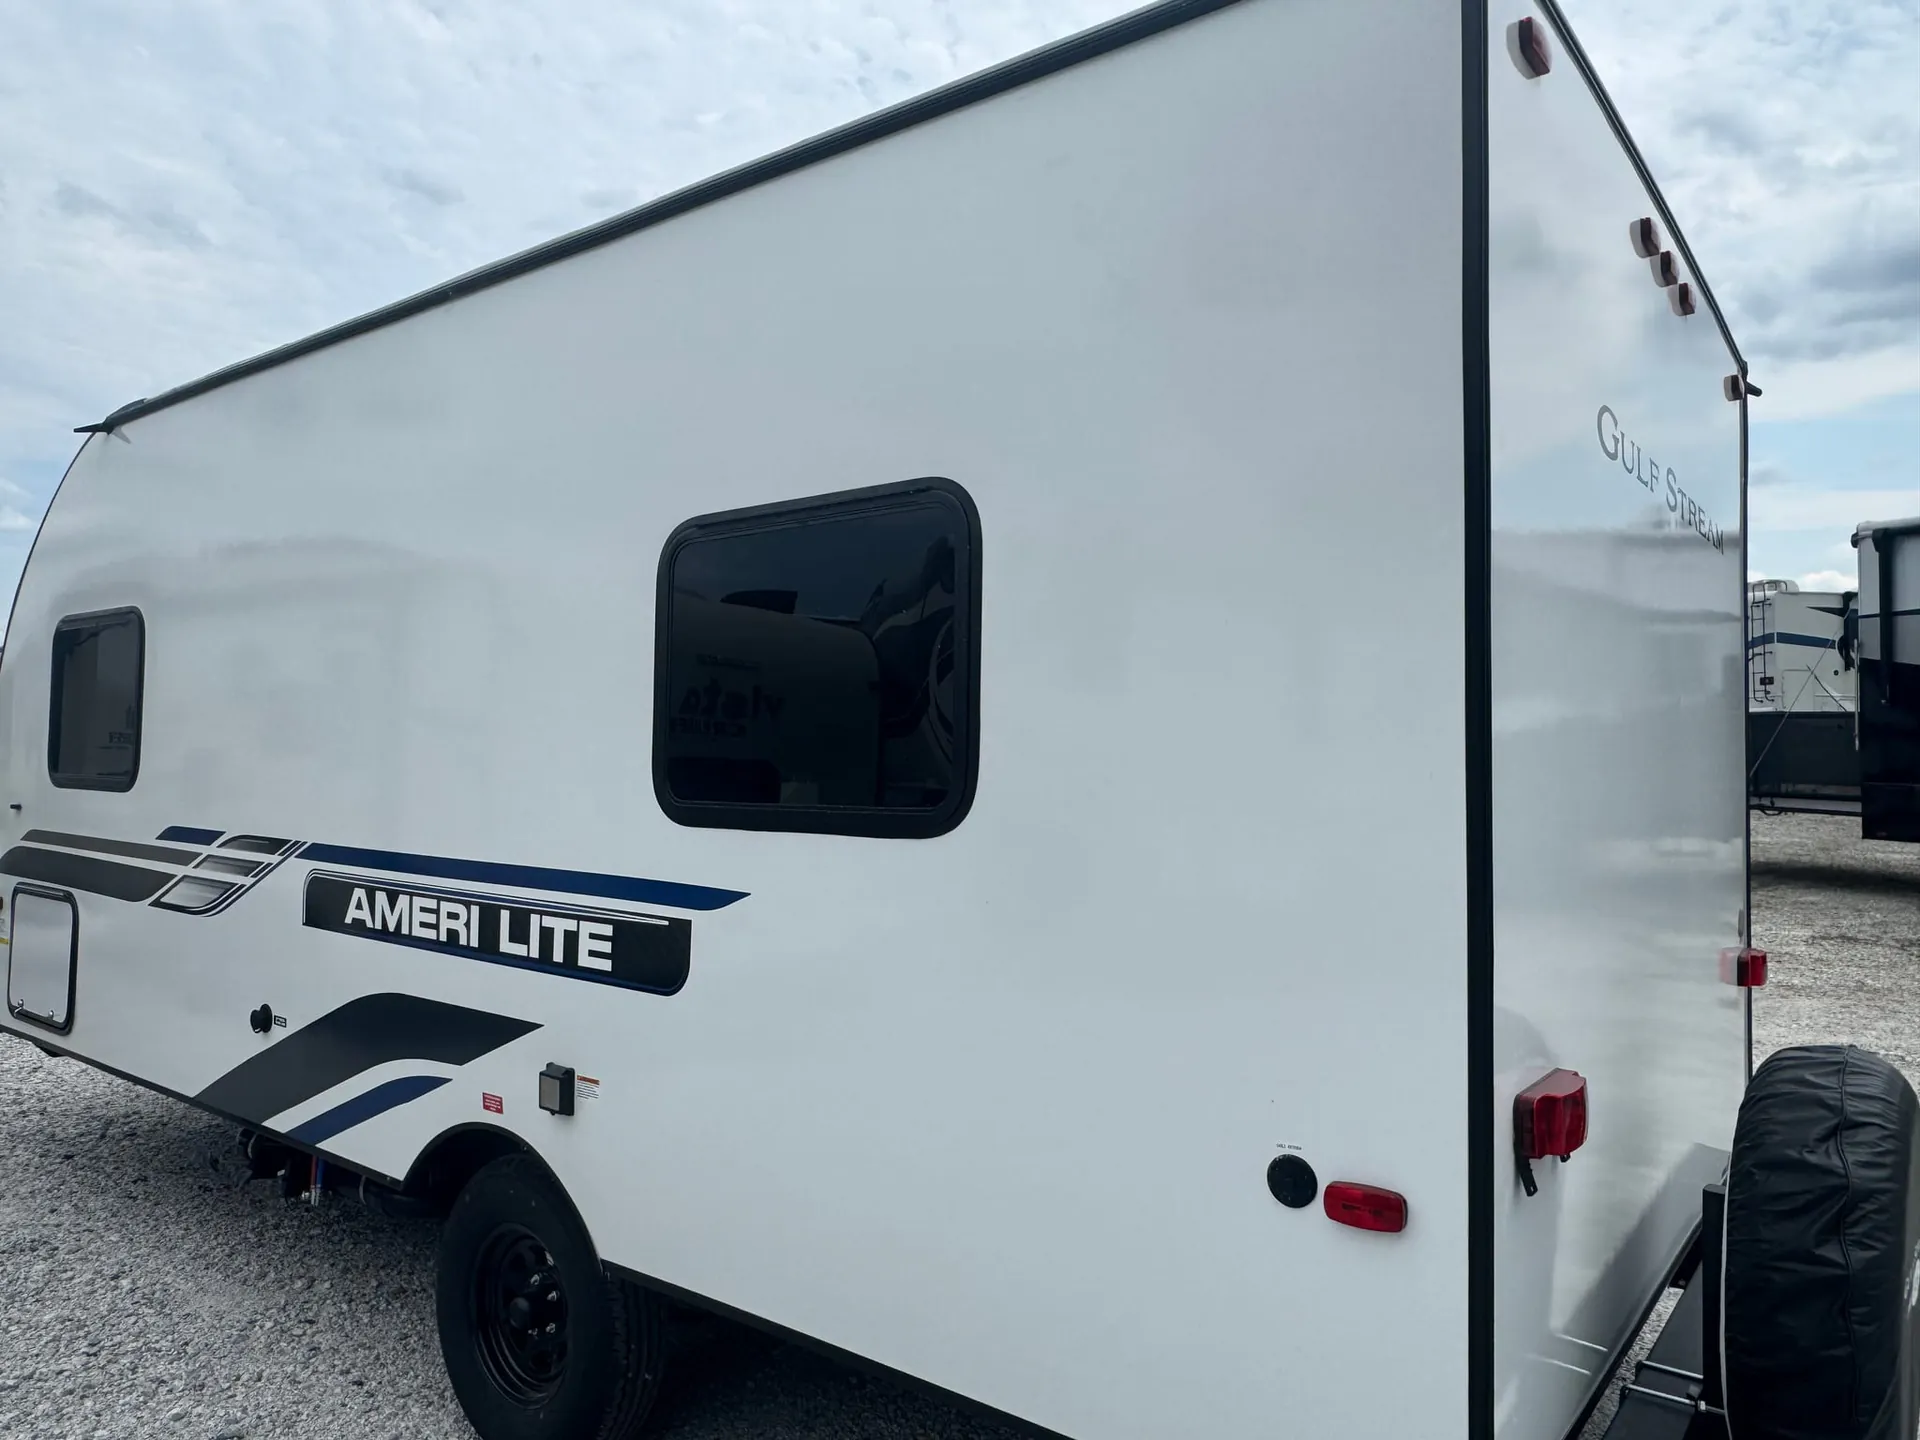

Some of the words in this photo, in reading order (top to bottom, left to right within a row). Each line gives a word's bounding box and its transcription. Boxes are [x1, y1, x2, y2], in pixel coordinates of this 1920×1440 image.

[1597, 404, 1660, 493] GULF
[1666, 467, 1724, 555] STREAM
[344, 887, 480, 948] AMERI
[499, 909, 614, 972] LITE
